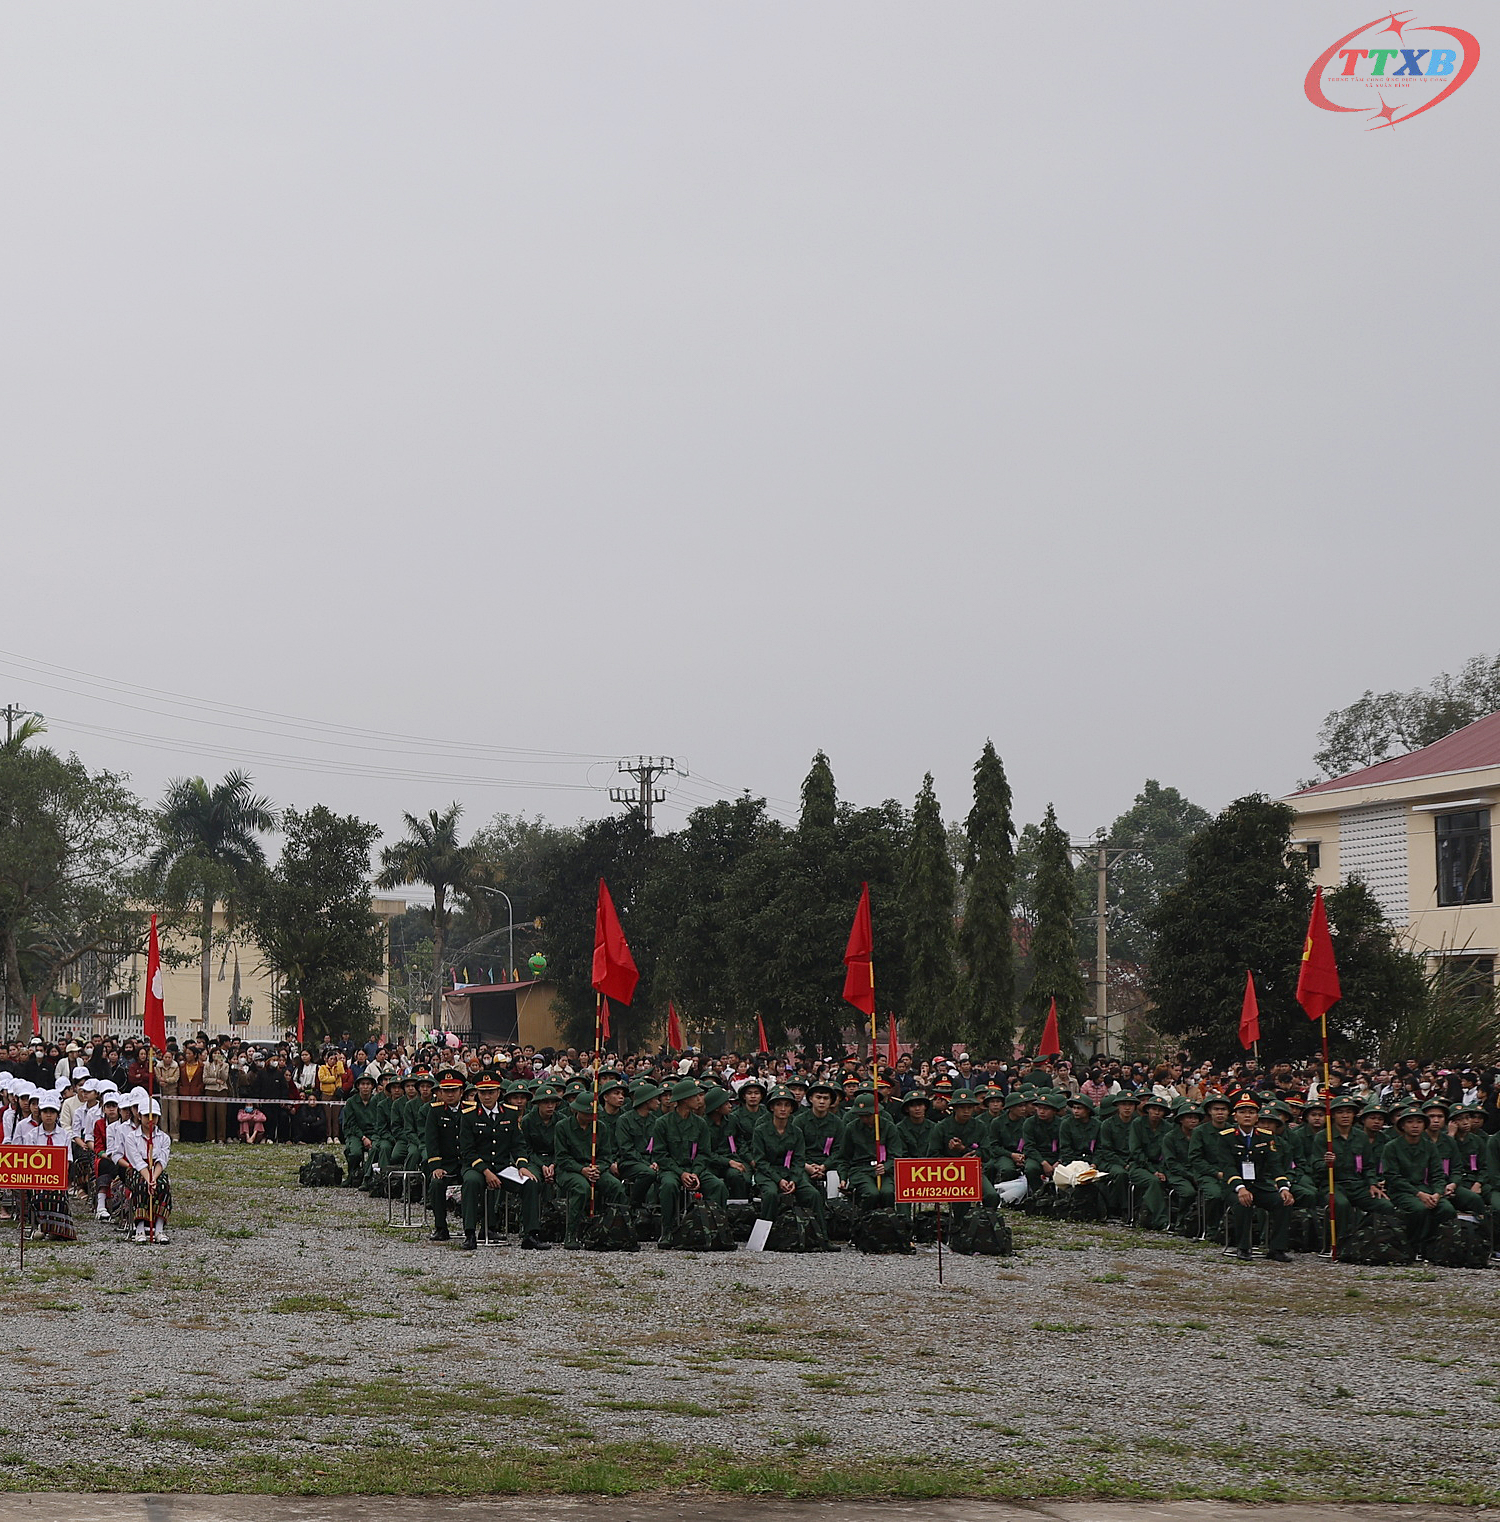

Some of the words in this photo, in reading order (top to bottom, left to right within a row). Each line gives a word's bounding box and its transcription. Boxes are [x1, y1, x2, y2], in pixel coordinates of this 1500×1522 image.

[911, 1162, 965, 1182] KHỐI
[10, 1173, 32, 1184] SINH
[34, 1174, 60, 1185] THCS
[903, 1186, 975, 1197] d14/f324/QK4
